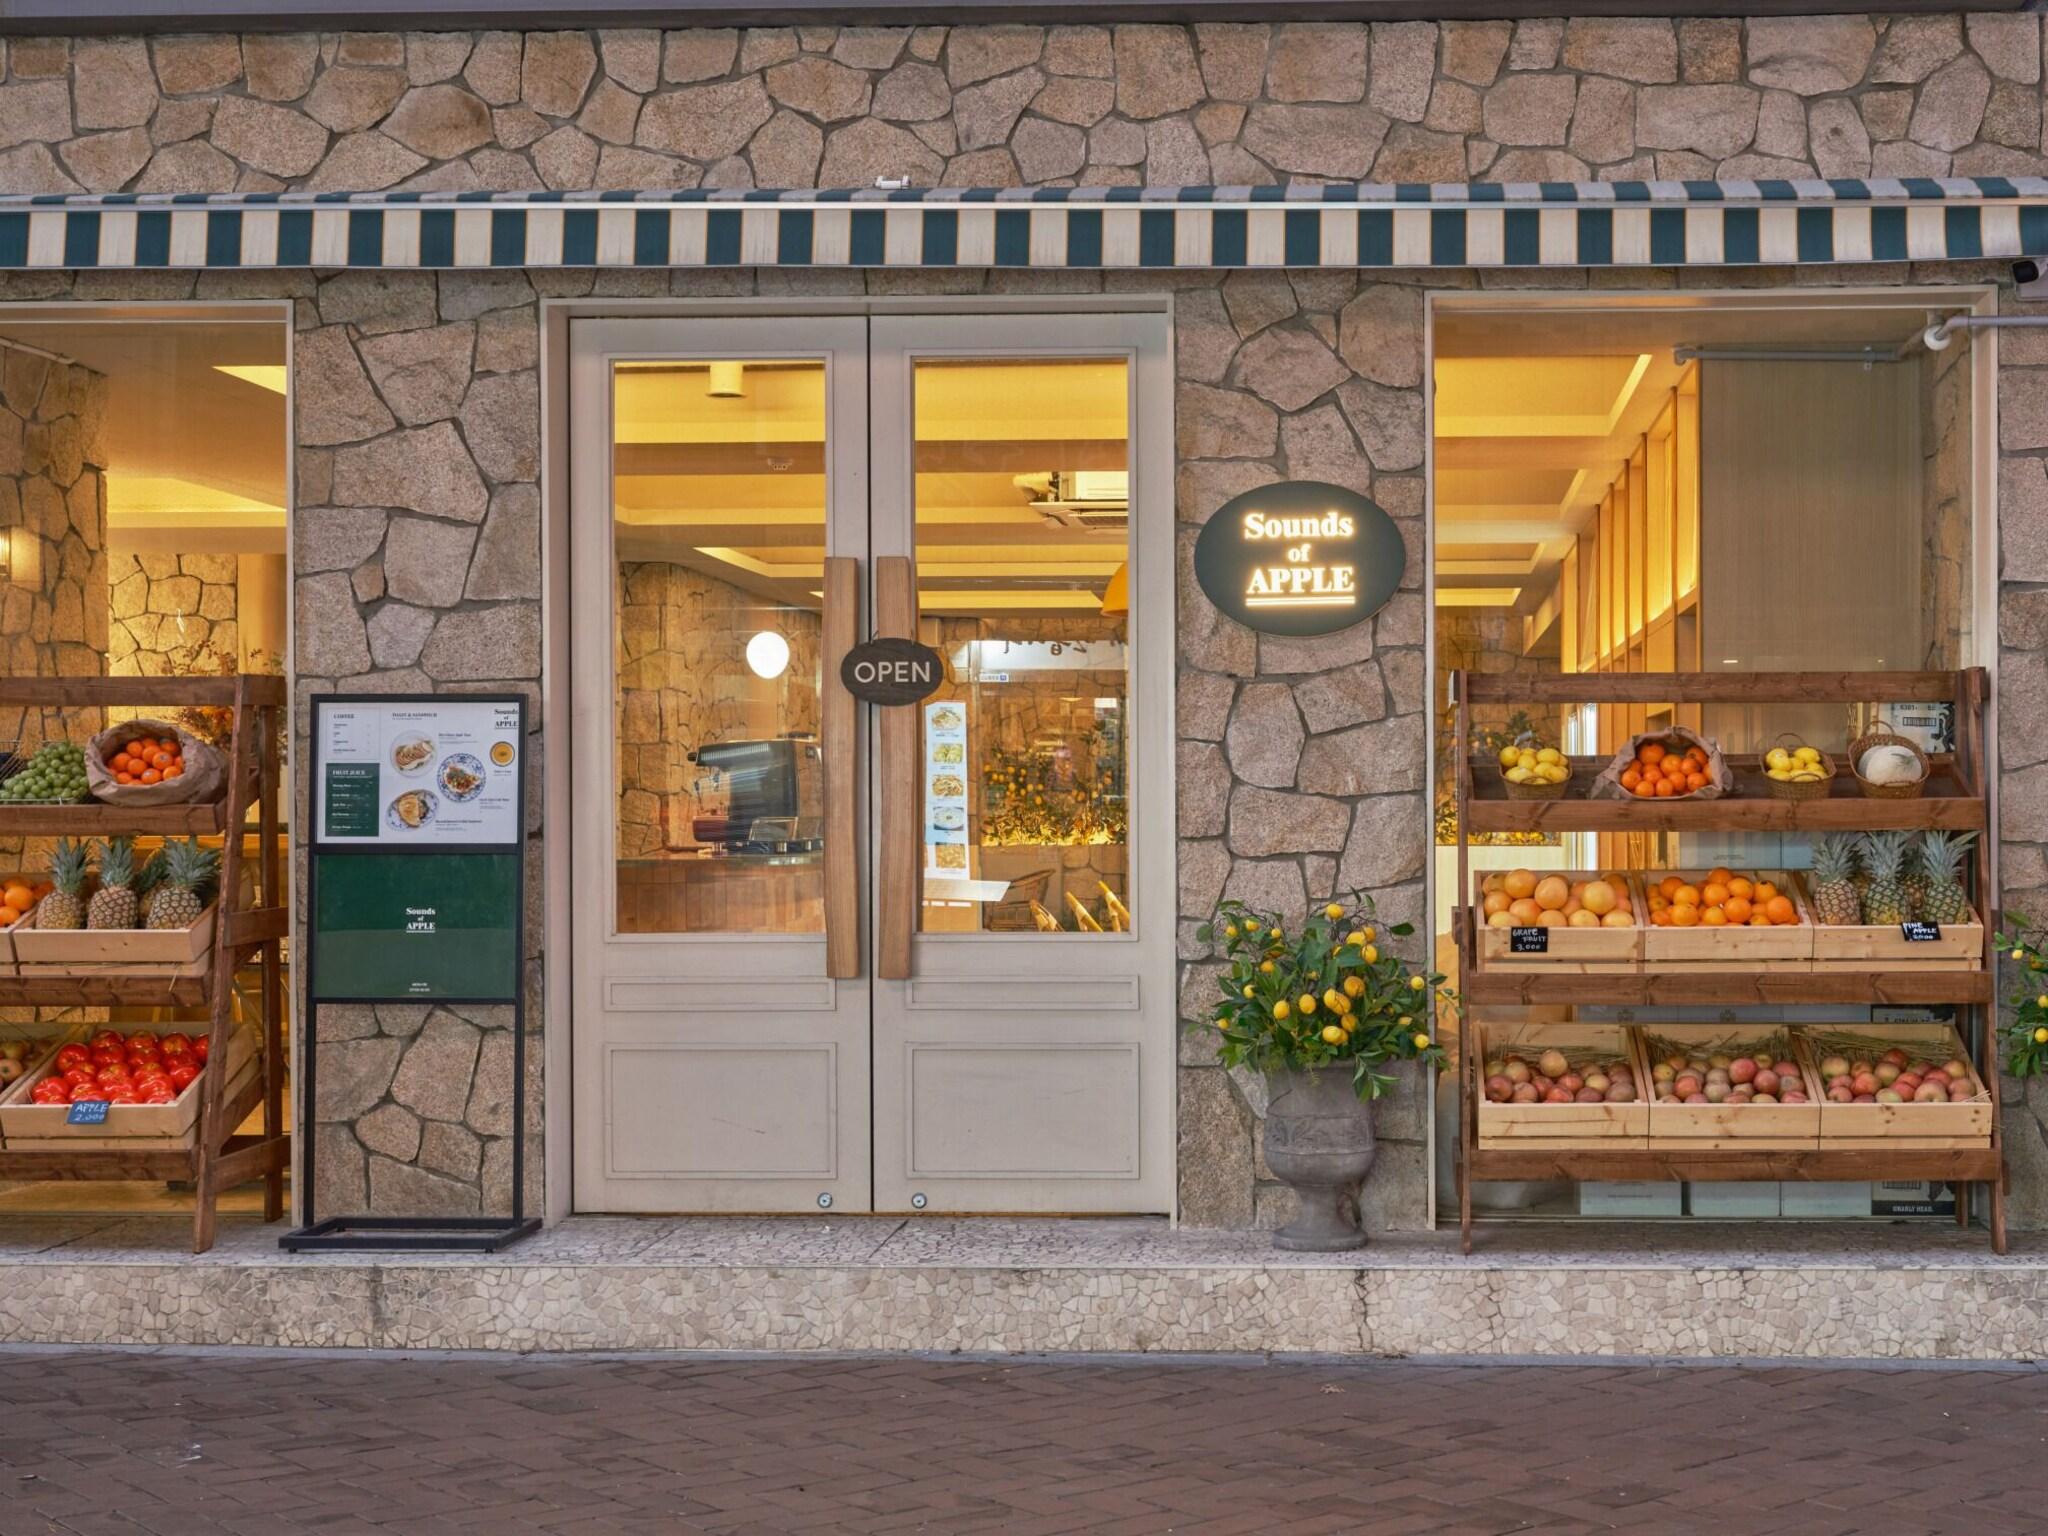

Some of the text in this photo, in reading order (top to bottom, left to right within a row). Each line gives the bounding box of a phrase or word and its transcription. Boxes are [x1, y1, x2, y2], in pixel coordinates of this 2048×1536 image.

[1244, 511, 1354, 539] Sounds
[1287, 543, 1311, 562] of
[1245, 566, 1355, 594] APPLE
[854, 661, 930, 683] OPEN
[405, 907, 436, 915] Sounds
[406, 922, 436, 930] APPLE
[1512, 928, 1538, 937] GRAPE
[75, 1103, 109, 1112] APPLE
